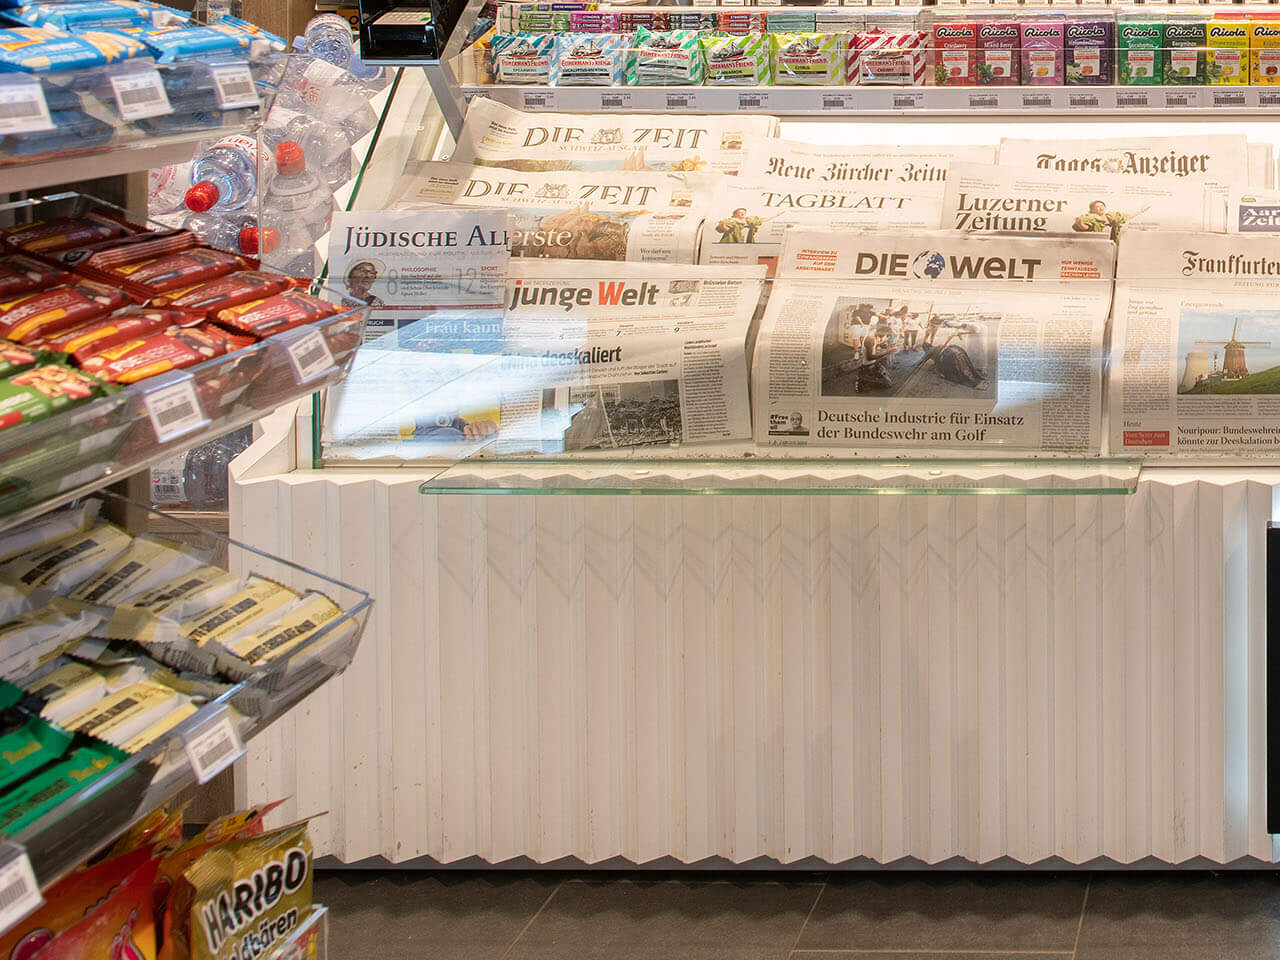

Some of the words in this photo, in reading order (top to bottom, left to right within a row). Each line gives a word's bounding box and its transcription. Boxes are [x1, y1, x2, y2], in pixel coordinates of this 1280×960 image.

[938, 26, 974, 38] Ricola
[981, 26, 1017, 38] Ricola
[1068, 26, 1105, 38] Ricola
[1167, 26, 1204, 38] Ricola
[522, 127, 585, 148] DIE
[632, 128, 711, 149] ZEIT
[765, 156, 816, 181] Neue
[822, 161, 893, 182] Zürcher
[1036, 153, 1101, 174] Tages
[1122, 150, 1210, 178] Anzeiger
[761, 192, 915, 209] TAGBLATT
[956, 193, 1069, 213] Luzerner
[955, 212, 1047, 232] Zeitung
[344, 224, 458, 254] JÜDISCHE
[855, 253, 909, 277] DIE
[509, 280, 592, 313] junge
[597, 280, 660, 306] Welt
[817, 410, 880, 424] Deutsche
[884, 411, 946, 425] Industrie
[949, 412, 971, 426] für
[975, 413, 1024, 427] Einsatz
[817, 427, 840, 439] der
[844, 427, 928, 440] Bundeswehr
[930, 431, 951, 440] am
[955, 428, 986, 442] Golf
[1177, 426, 1221, 437] Nouripour:
[1177, 437, 1205, 445] könnte
[1221, 436, 1272, 446] Deeskalation
[203, 848, 309, 954] HARIBO
